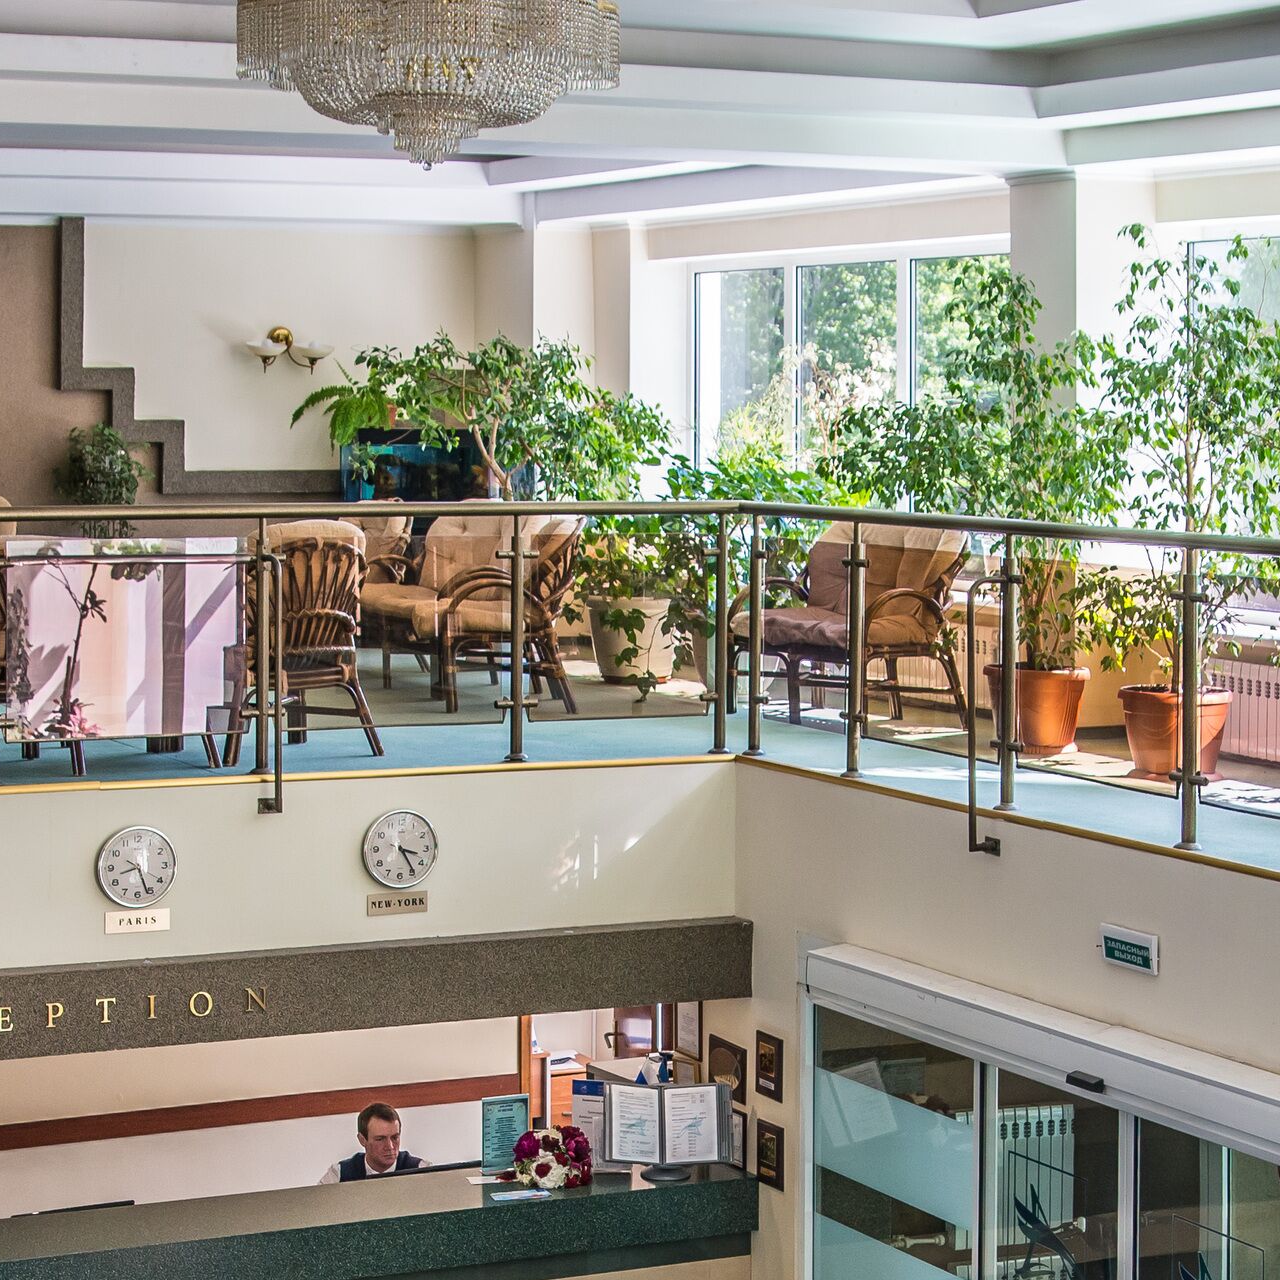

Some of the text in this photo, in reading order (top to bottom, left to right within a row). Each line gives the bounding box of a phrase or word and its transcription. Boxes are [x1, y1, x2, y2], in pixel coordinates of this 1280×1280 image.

[156, 876, 163, 884] 4
[122, 888, 128, 896] 7
[118, 916, 157, 926] PARIS
[1106, 939, 1150, 957] ЗАПАСНЫЙ
[1114, 950, 1143, 965] ВЫХОД
